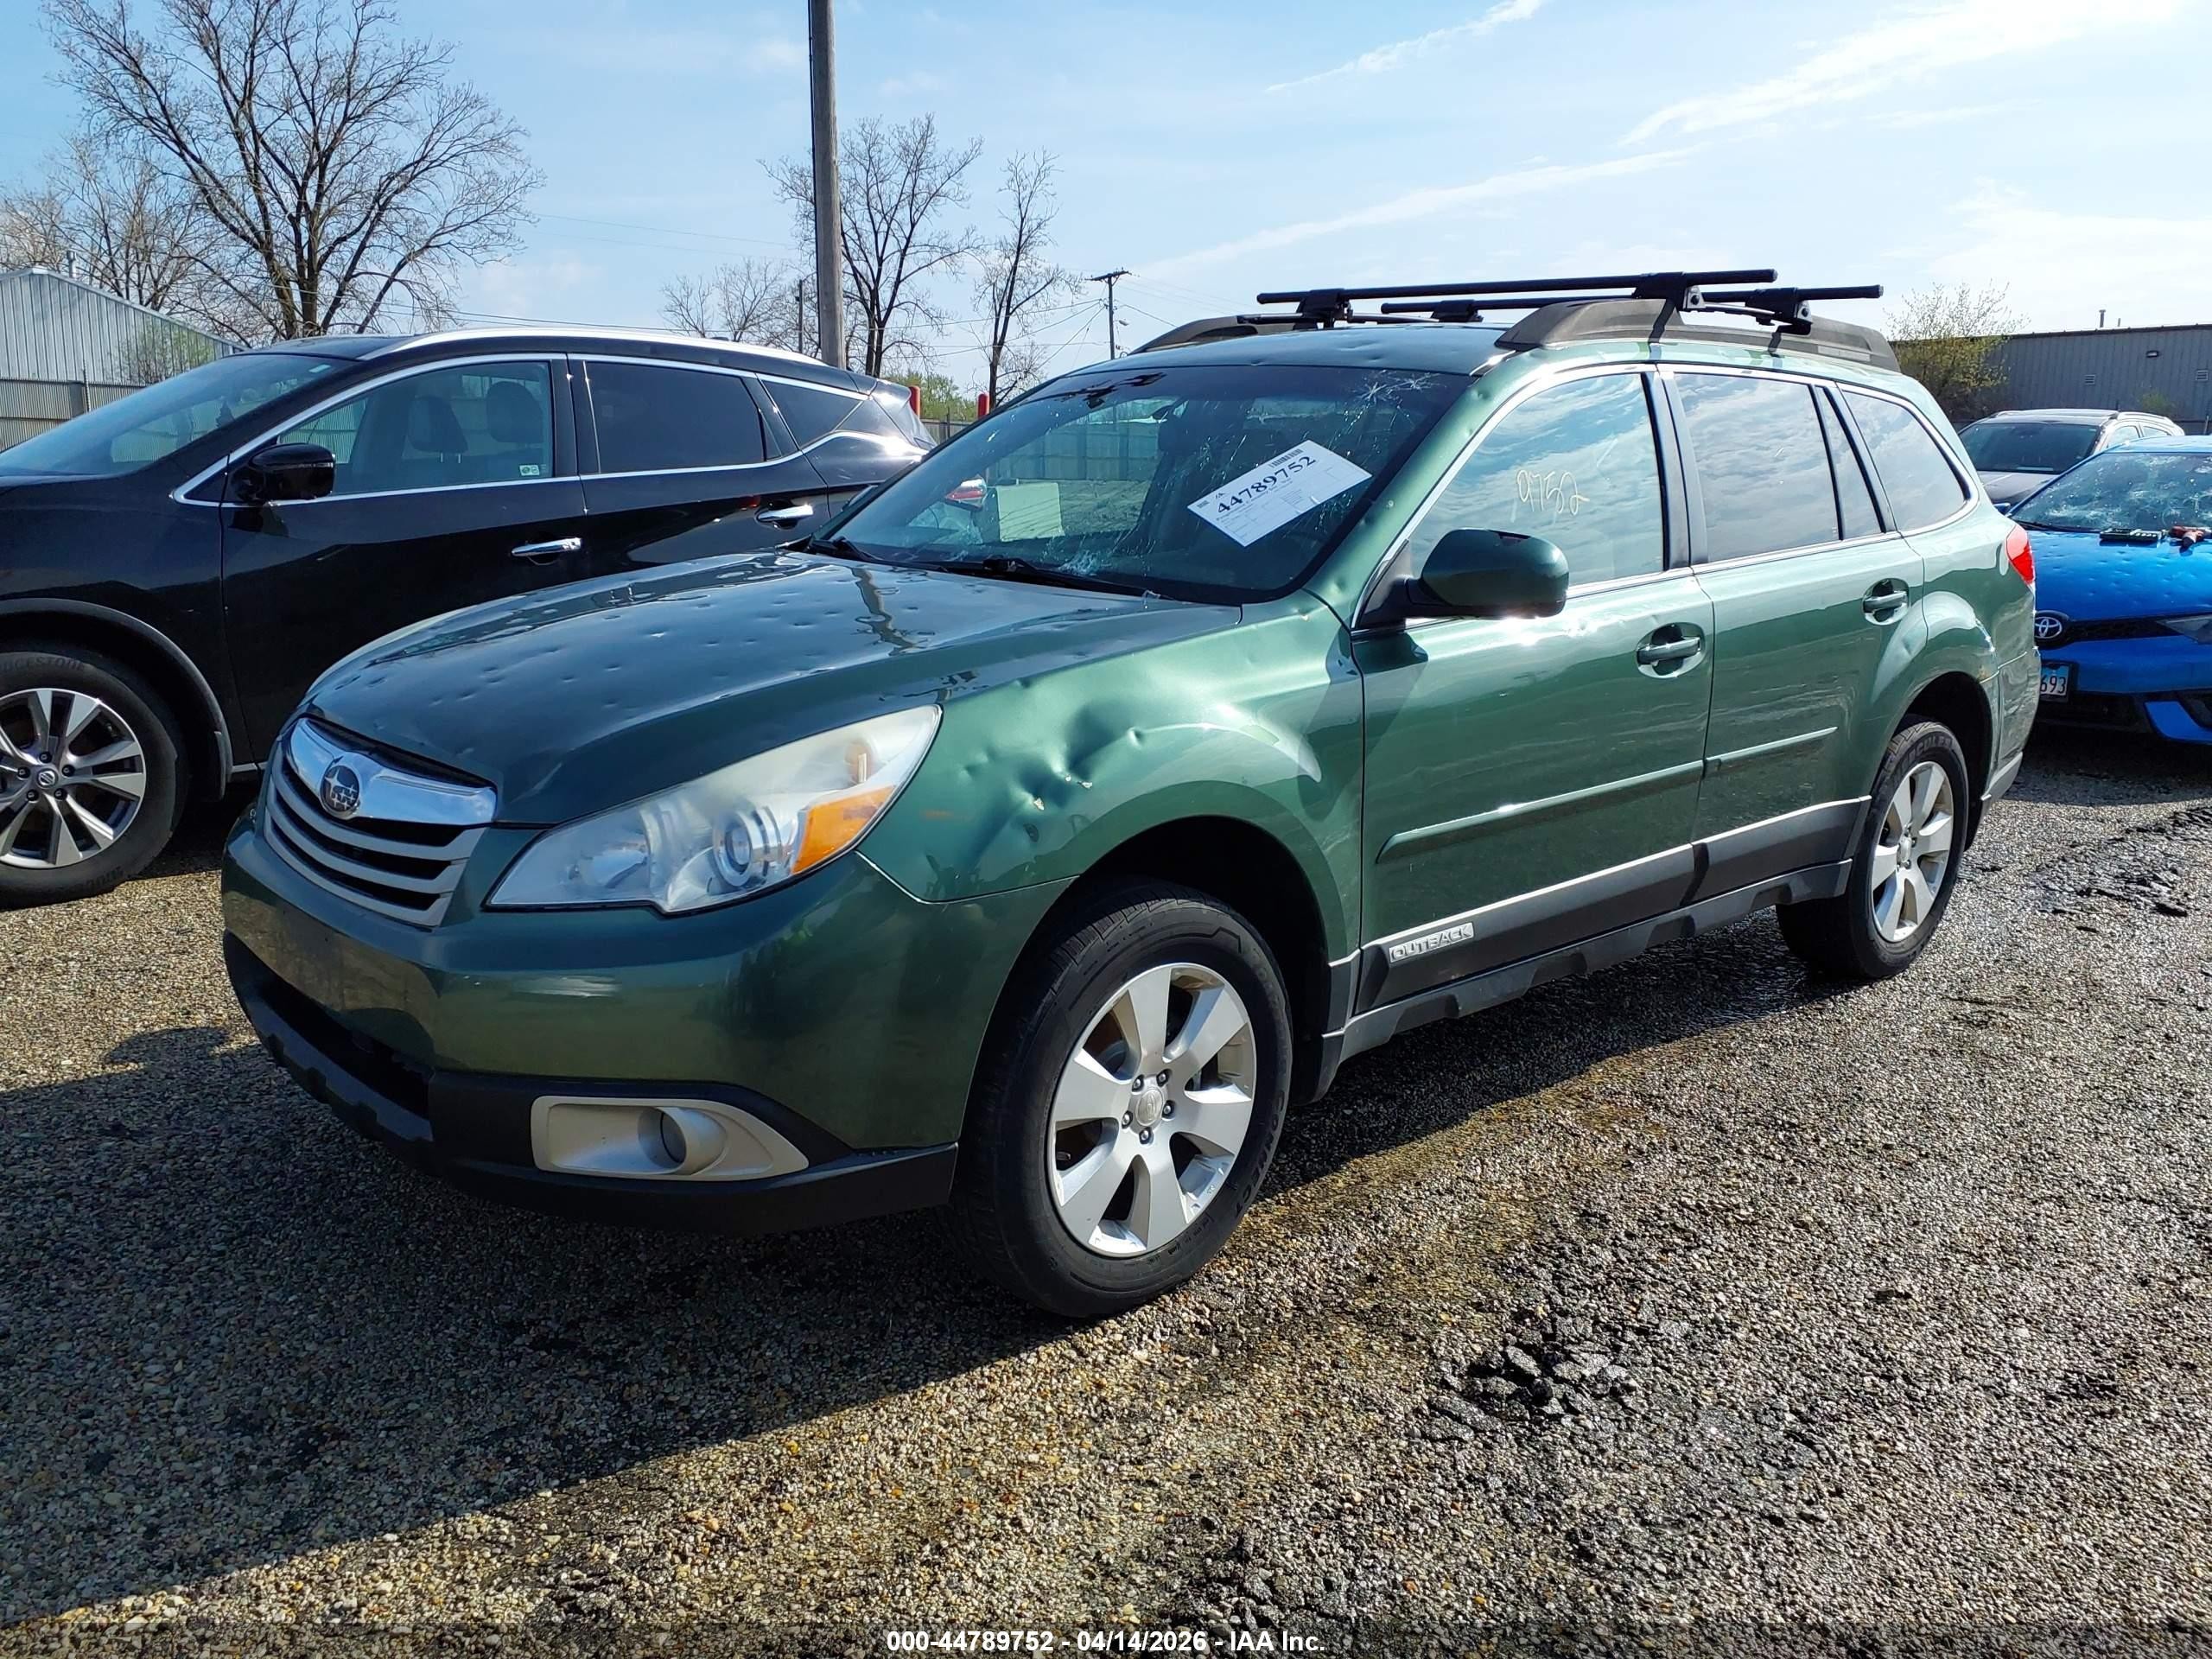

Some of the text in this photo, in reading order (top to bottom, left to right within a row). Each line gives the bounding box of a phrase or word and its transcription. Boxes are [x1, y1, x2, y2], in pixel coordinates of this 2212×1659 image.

[1217, 455, 1316, 514] 44789752
[1516, 469, 1590, 516] 9752
[1390, 924, 1473, 961] OUTBACK
